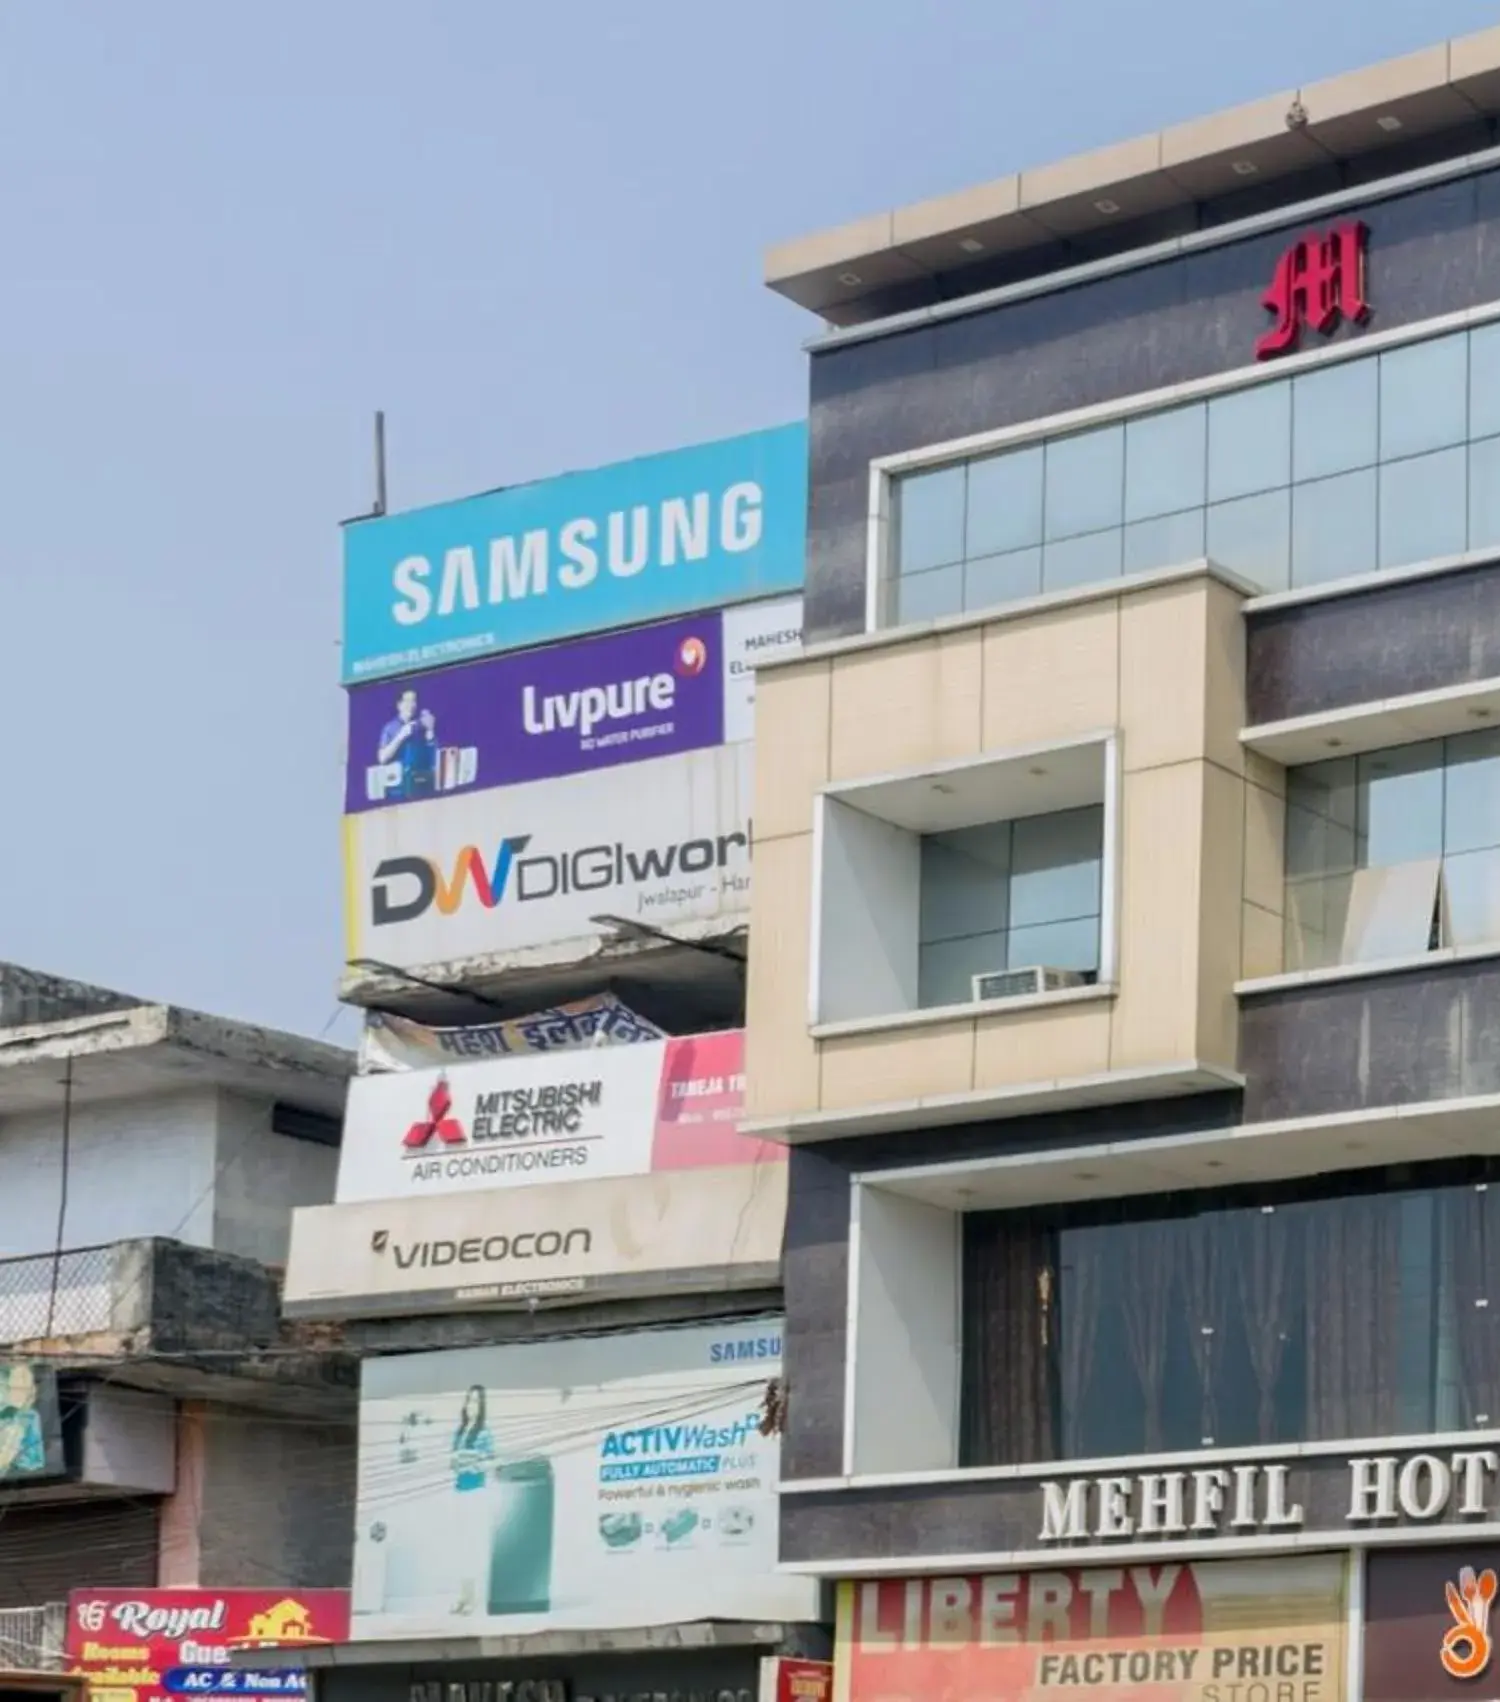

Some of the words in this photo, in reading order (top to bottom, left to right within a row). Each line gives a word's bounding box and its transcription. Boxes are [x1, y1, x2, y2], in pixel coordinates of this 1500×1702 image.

[391, 481, 763, 626] SAMSUNG
[522, 672, 676, 735] Livpure
[475, 1081, 603, 1114] MITSUBISHI
[472, 1107, 582, 1142] ELECTRIC
[411, 1157, 444, 1182] AIR
[446, 1146, 589, 1179] CONDITIONERS
[393, 1227, 593, 1270] VIDEOCON
[602, 1463, 641, 1480] FULLY
[643, 1456, 716, 1476] AUTOMATIC
[1037, 1463, 1304, 1543] MEHFIL
[112, 1599, 226, 1638] Royal
[858, 1562, 1187, 1654] LIBERTY
[183, 1673, 214, 1689] AC
[219, 1673, 237, 1689] &
[1039, 1648, 1200, 1685] FACTORY
[1212, 1644, 1324, 1679] PRICE
